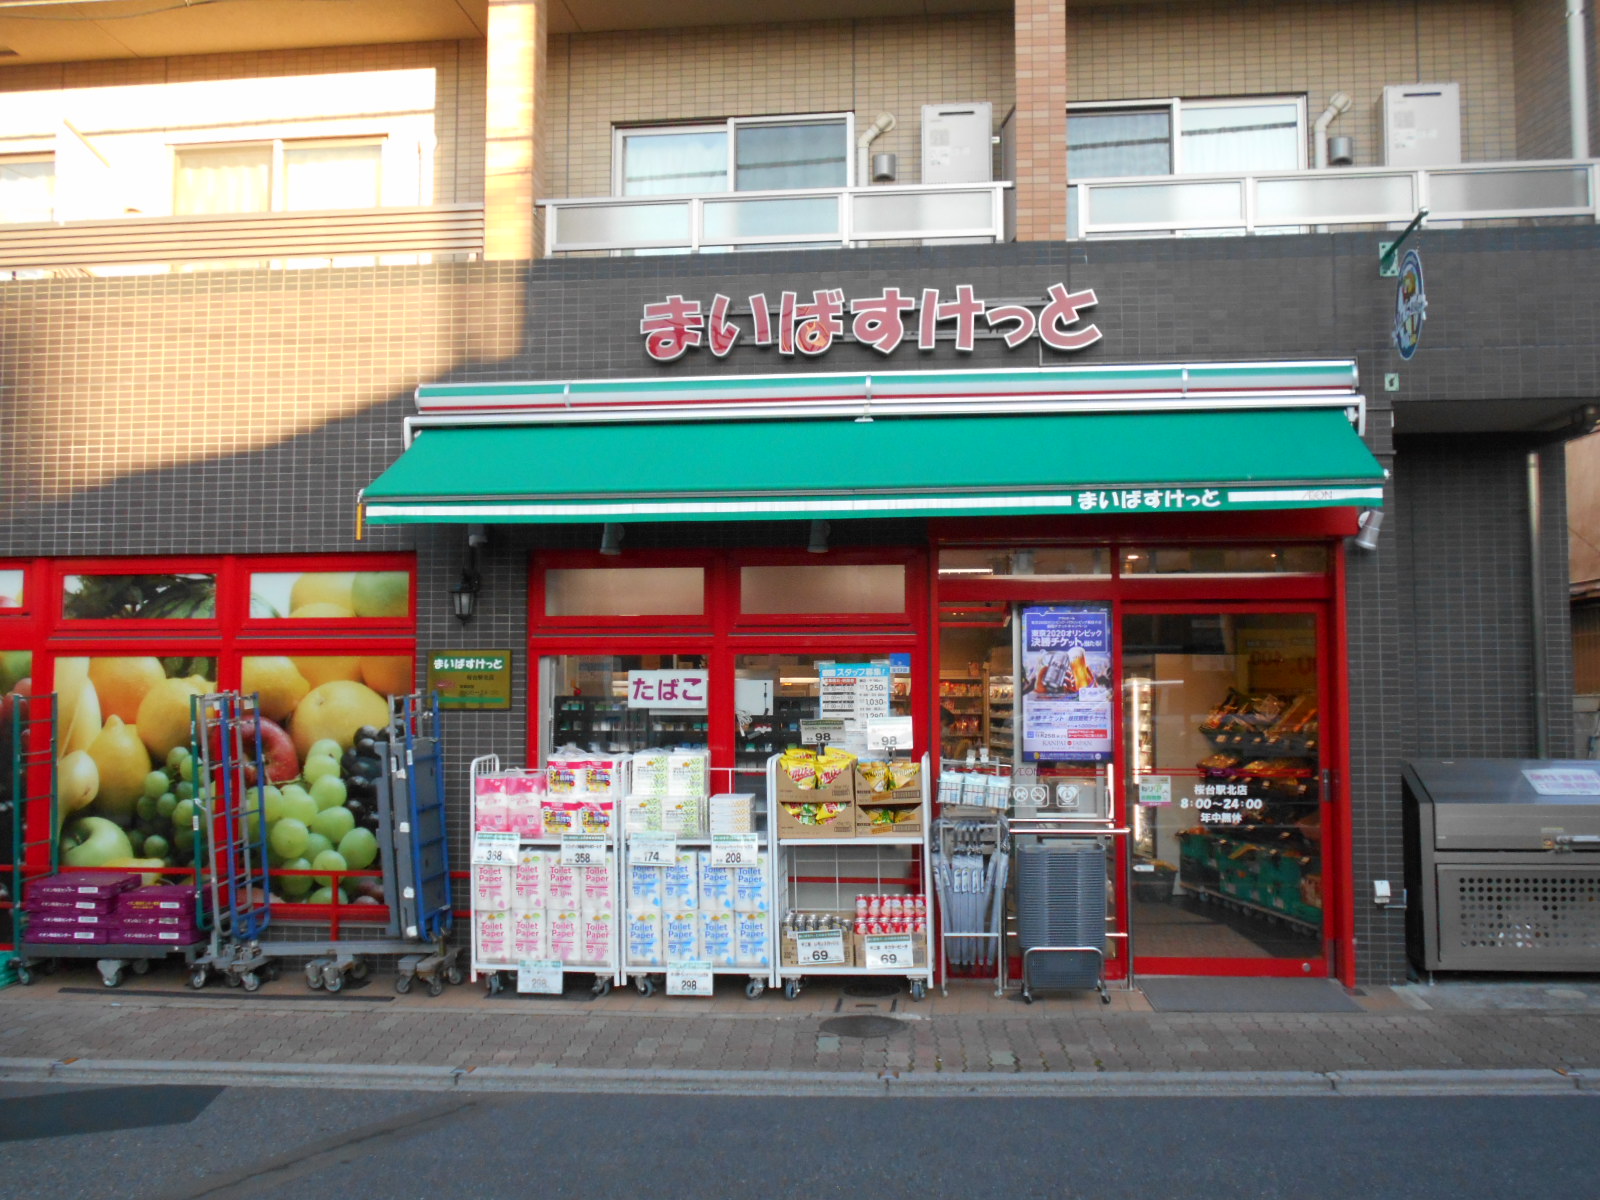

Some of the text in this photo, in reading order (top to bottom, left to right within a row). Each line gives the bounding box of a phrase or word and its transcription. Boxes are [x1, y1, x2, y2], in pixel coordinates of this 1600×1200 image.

[640, 283, 1102, 361] まいばすけっと
[1078, 489, 1221, 510] まいばすけっと
[434, 658, 502, 670] まいばすけっと
[633, 678, 702, 700] たばこ
[815, 733, 831, 741] 98
[881, 736, 898, 746] 98
[789, 766, 816, 780] Mike
[1194, 784, 1248, 796] 桜台駅北店
[1200, 812, 1242, 823] 年中無休
[575, 853, 590, 863] 358
[725, 853, 741, 863] 208
[517, 865, 538, 873] Toilet
[517, 873, 539, 881] Paper
[551, 874, 572, 882] Paper
[633, 872, 656, 880] Paper
[704, 874, 727, 882] Paper
[482, 922, 503, 930] Toilet
[631, 923, 652, 931] Toilet
[741, 922, 763, 930] Toilet
[482, 930, 504, 938] Paper
[587, 931, 609, 939] Paper
[812, 950, 828, 960] 69
[880, 954, 897, 964] 69
[681, 980, 696, 991] 298
